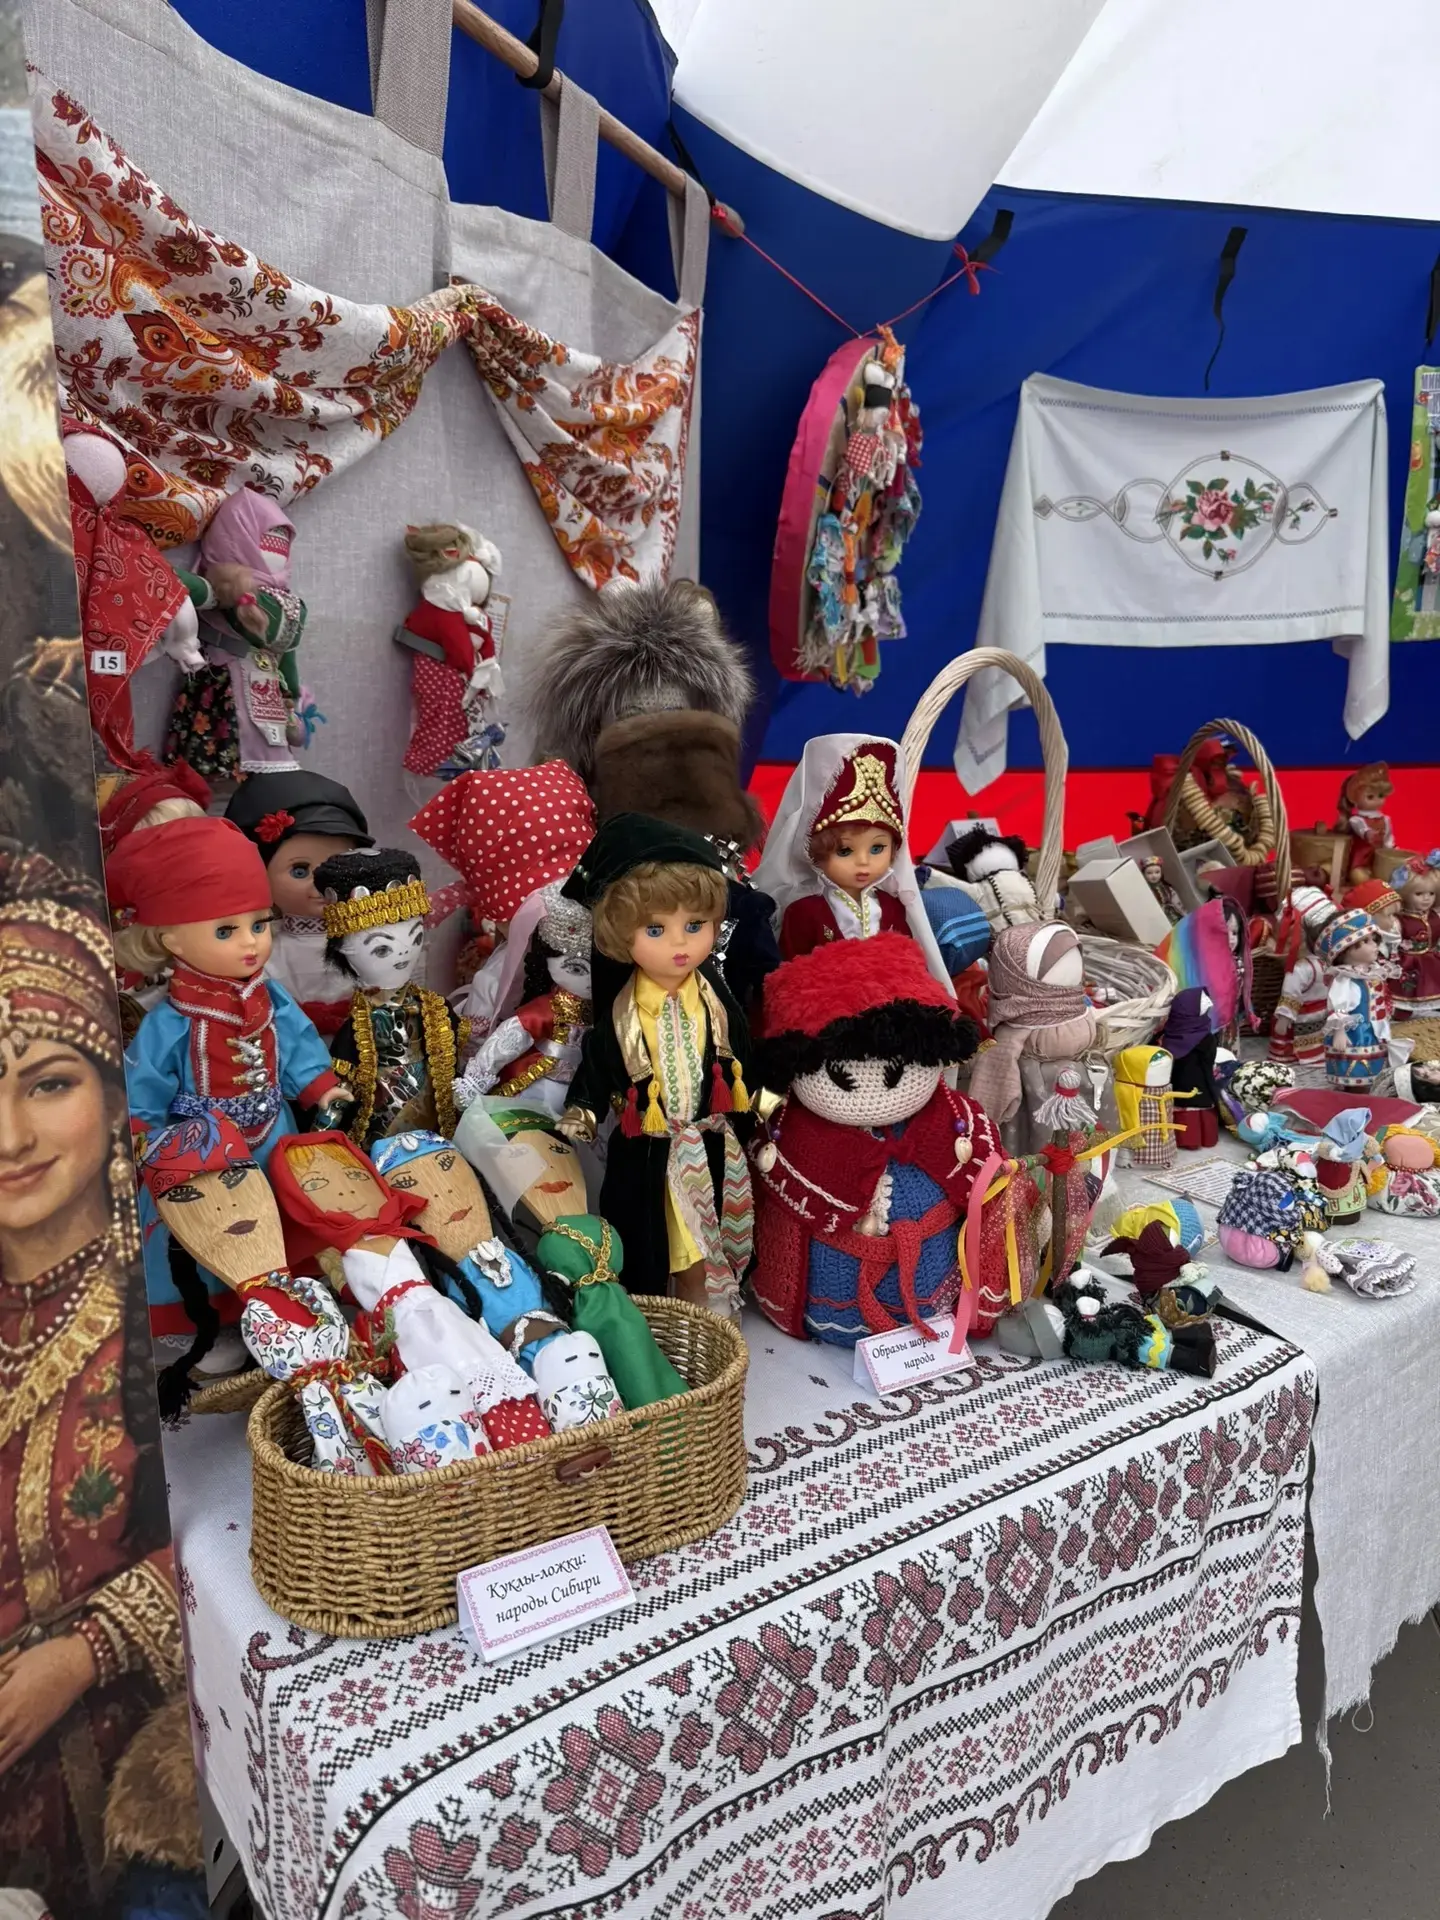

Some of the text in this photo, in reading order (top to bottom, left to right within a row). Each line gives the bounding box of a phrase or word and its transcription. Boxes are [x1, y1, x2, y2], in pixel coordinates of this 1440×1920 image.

[98, 655, 118, 670] 15
[872, 1330, 950, 1360] Образы шорого
[903, 1352, 936, 1370] народа
[486, 1552, 587, 1599] Куклы-ложки:
[496, 1574, 601, 1623] народы Сибири
